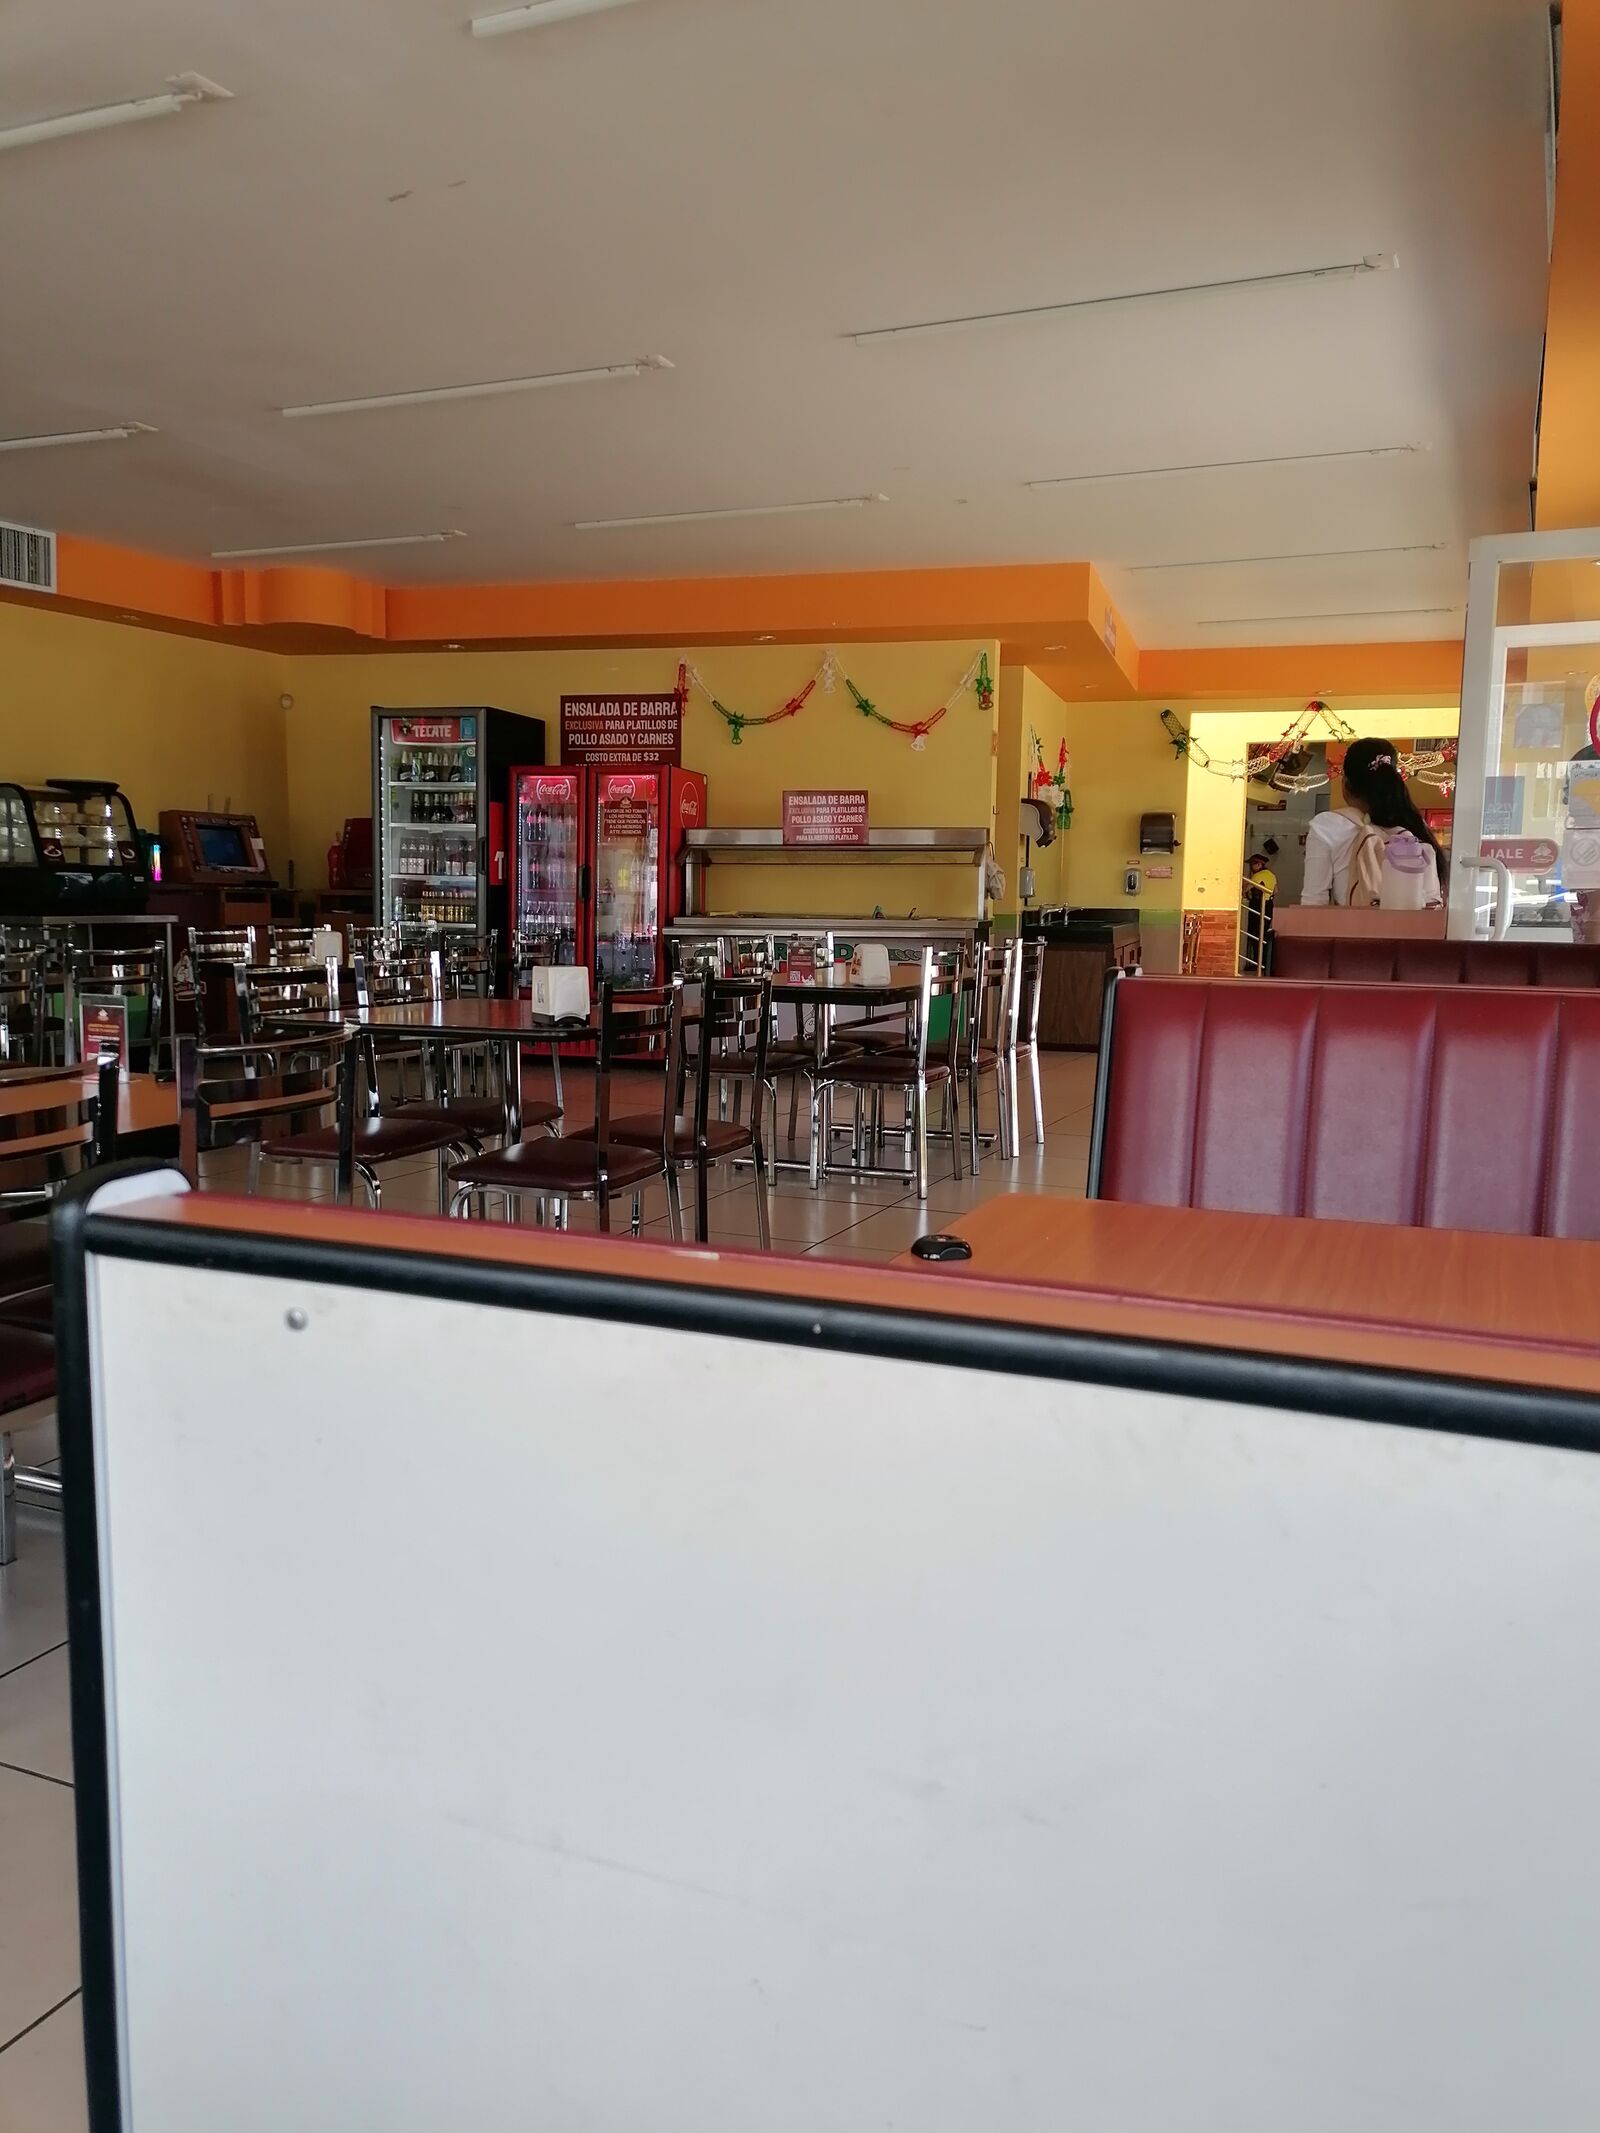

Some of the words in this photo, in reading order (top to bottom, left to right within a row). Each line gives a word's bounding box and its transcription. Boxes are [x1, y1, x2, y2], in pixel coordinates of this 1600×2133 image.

[565, 702, 621, 717] ENSALADA
[623, 702, 638, 716] DE
[640, 701, 678, 716] BARRA
[565, 720, 605, 730] EXCLUSIVA
[605, 720, 626, 730] PARA
[626, 720, 667, 730] PLATILLOS
[667, 719, 678, 730] DE
[411, 725, 452, 738] TECATE
[568, 733, 598, 745] POLLO
[599, 733, 629, 745] ASADO
[630, 733, 637, 745] Y
[637, 733, 674, 745] CARNES
[585, 752, 608, 762] COSTO
[609, 752, 632, 762] EXTRA
[632, 752, 642, 762] DE
[643, 752, 660, 761] $32
[788, 795, 827, 806] ENSALADA
[828, 795, 838, 805] DE
[839, 795, 866, 805] BARRA
[830, 806, 858, 814] PLATILLOS
[791, 815, 812, 824] POLLO
[812, 815, 832, 824] ASADO
[832, 815, 838, 823] Y
[838, 815, 863, 823] CARNES
[1487, 848, 1524, 859] JALE
